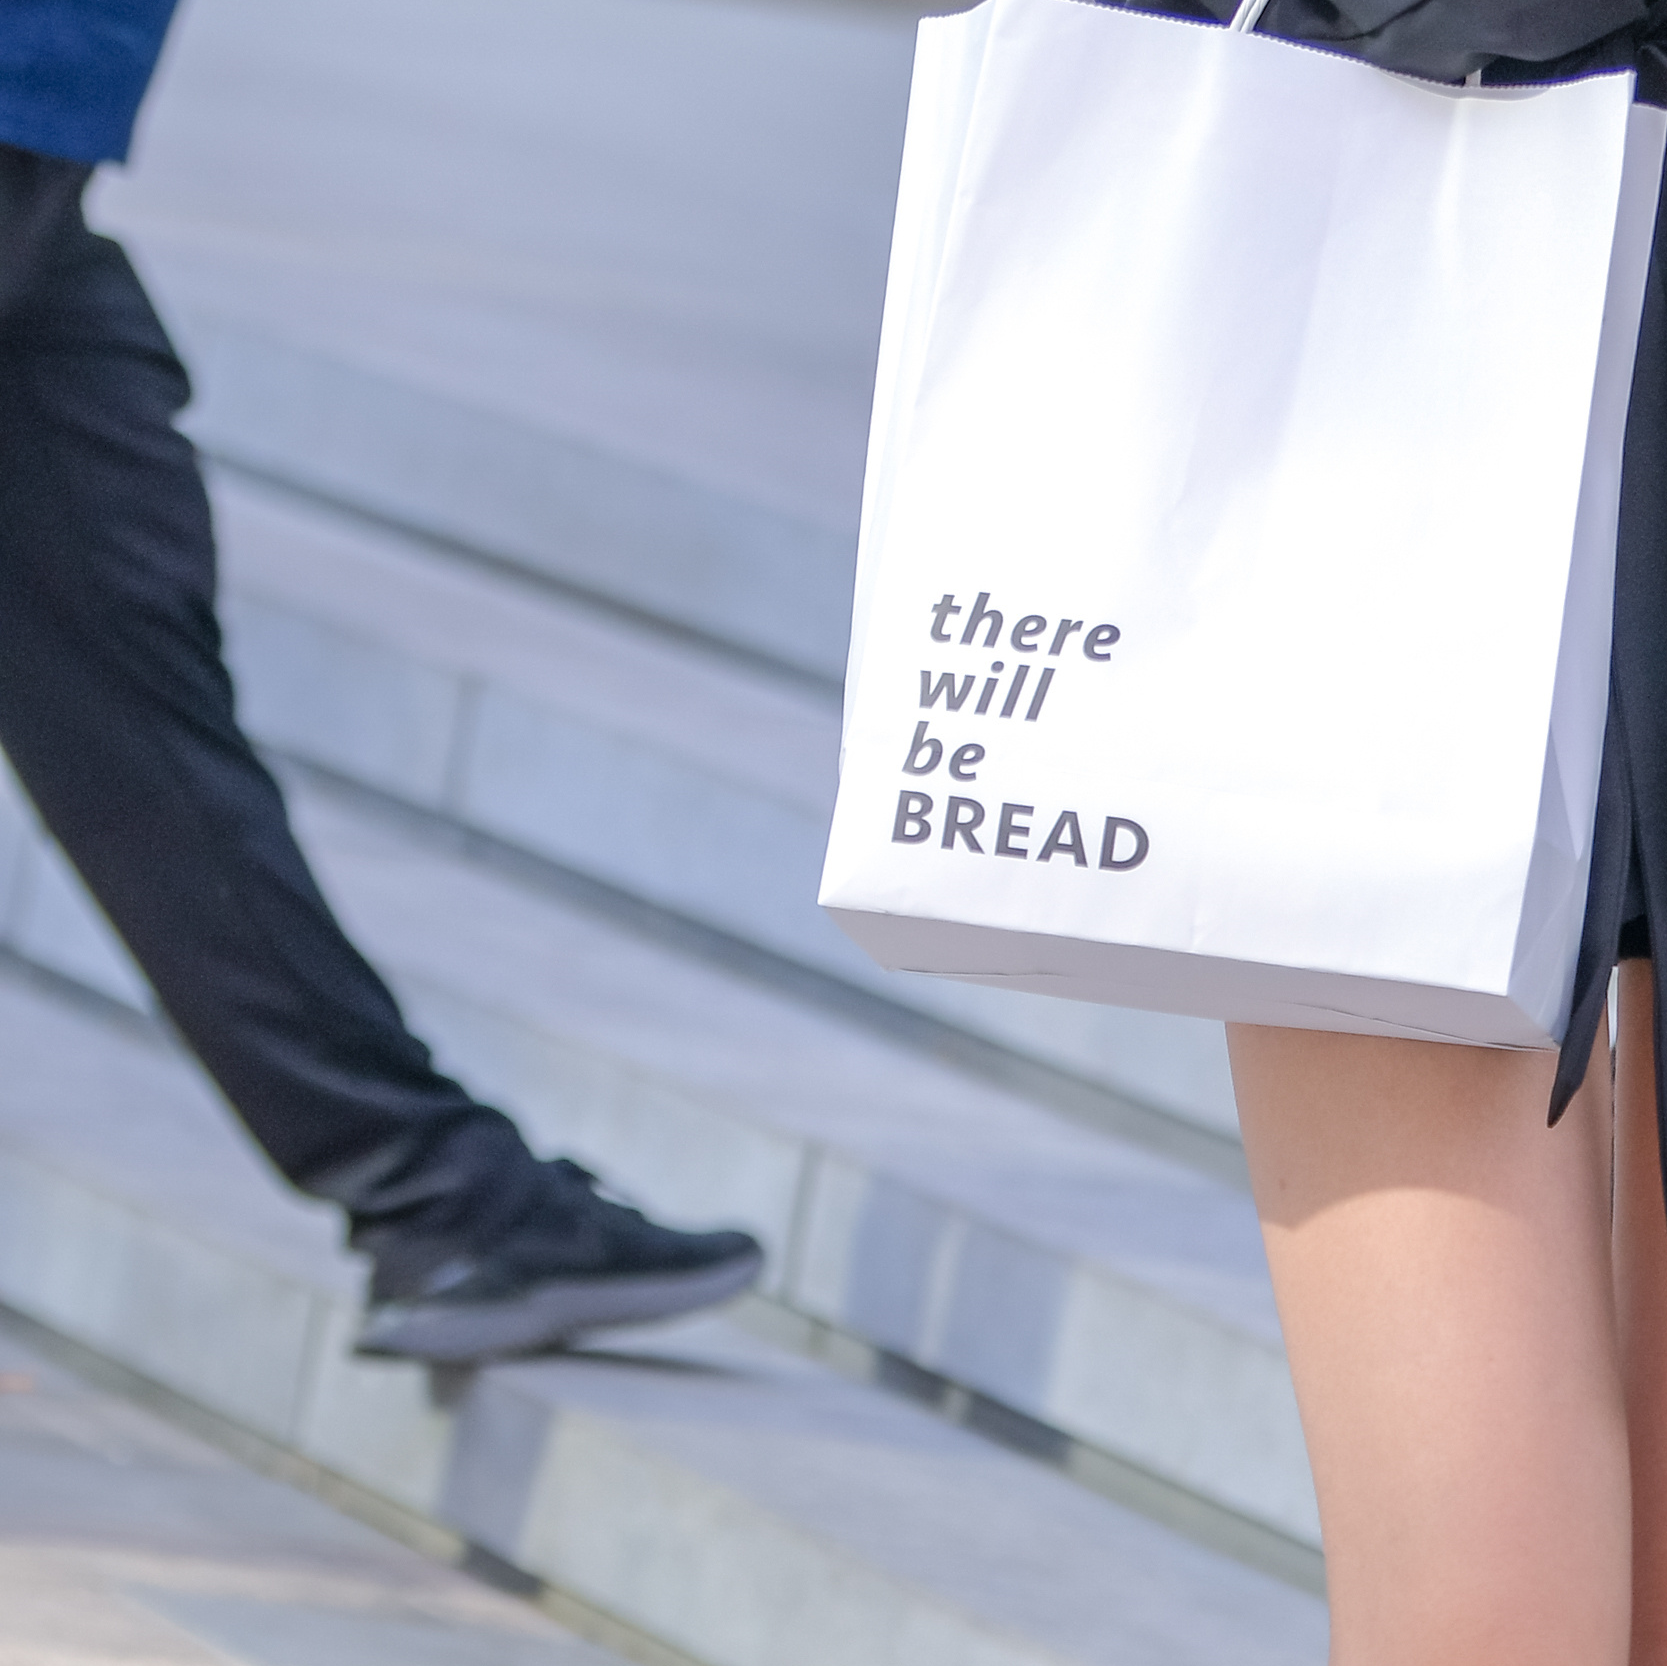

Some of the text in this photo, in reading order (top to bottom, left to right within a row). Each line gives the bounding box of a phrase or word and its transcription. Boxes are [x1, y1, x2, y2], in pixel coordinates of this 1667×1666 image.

[929, 591, 1122, 663] there
[918, 660, 1057, 723] will
[900, 720, 986, 783] be
[891, 789, 1150, 873] BREAD
